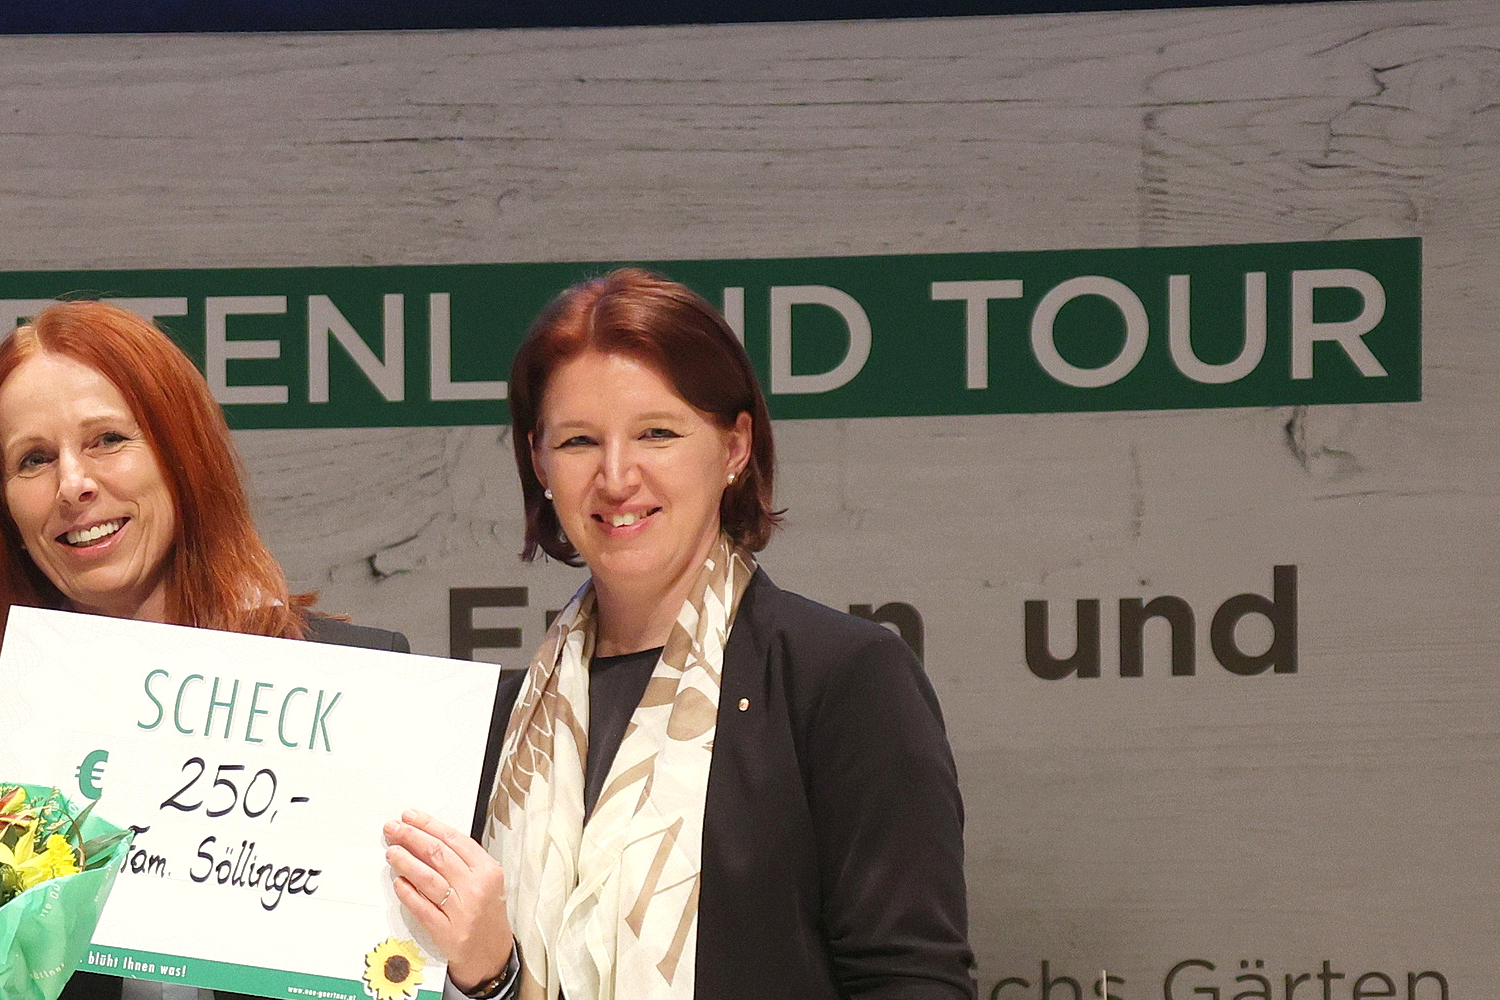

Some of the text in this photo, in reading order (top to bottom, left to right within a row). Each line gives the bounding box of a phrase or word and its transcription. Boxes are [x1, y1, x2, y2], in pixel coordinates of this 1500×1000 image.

[930, 268, 1389, 390] TOUR
[1024, 564, 1299, 680] und
[136, 668, 342, 752] SCHECK
[159, 756, 310, 823] 250,-
[189, 835, 323, 911] Söllinger
[88, 950, 187, 977] blüht Ihnen was!
